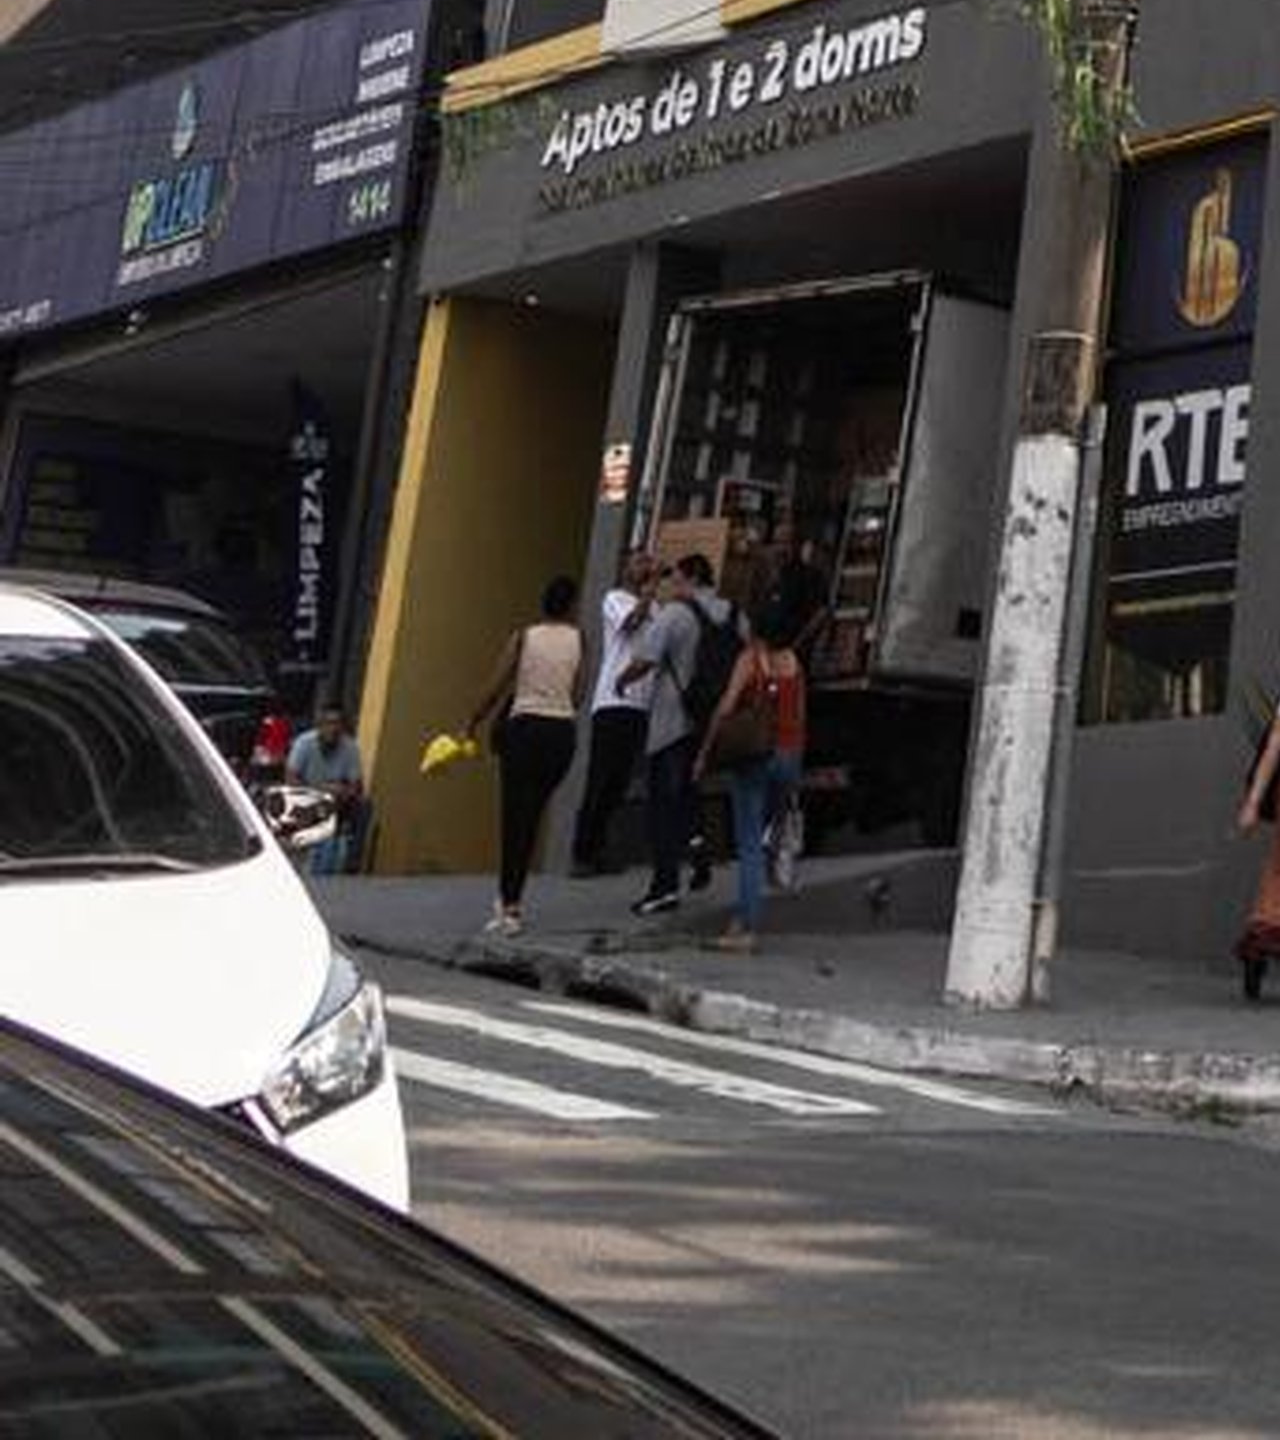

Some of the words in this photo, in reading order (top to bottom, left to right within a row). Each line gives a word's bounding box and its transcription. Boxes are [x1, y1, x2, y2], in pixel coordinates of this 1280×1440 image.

[540, 95, 647, 173] Aptos
[651, 69, 699, 135] de
[706, 59, 726, 118] 1
[728, 61, 754, 111] e
[758, 40, 789, 102] 2
[793, 7, 927, 90] dorms
